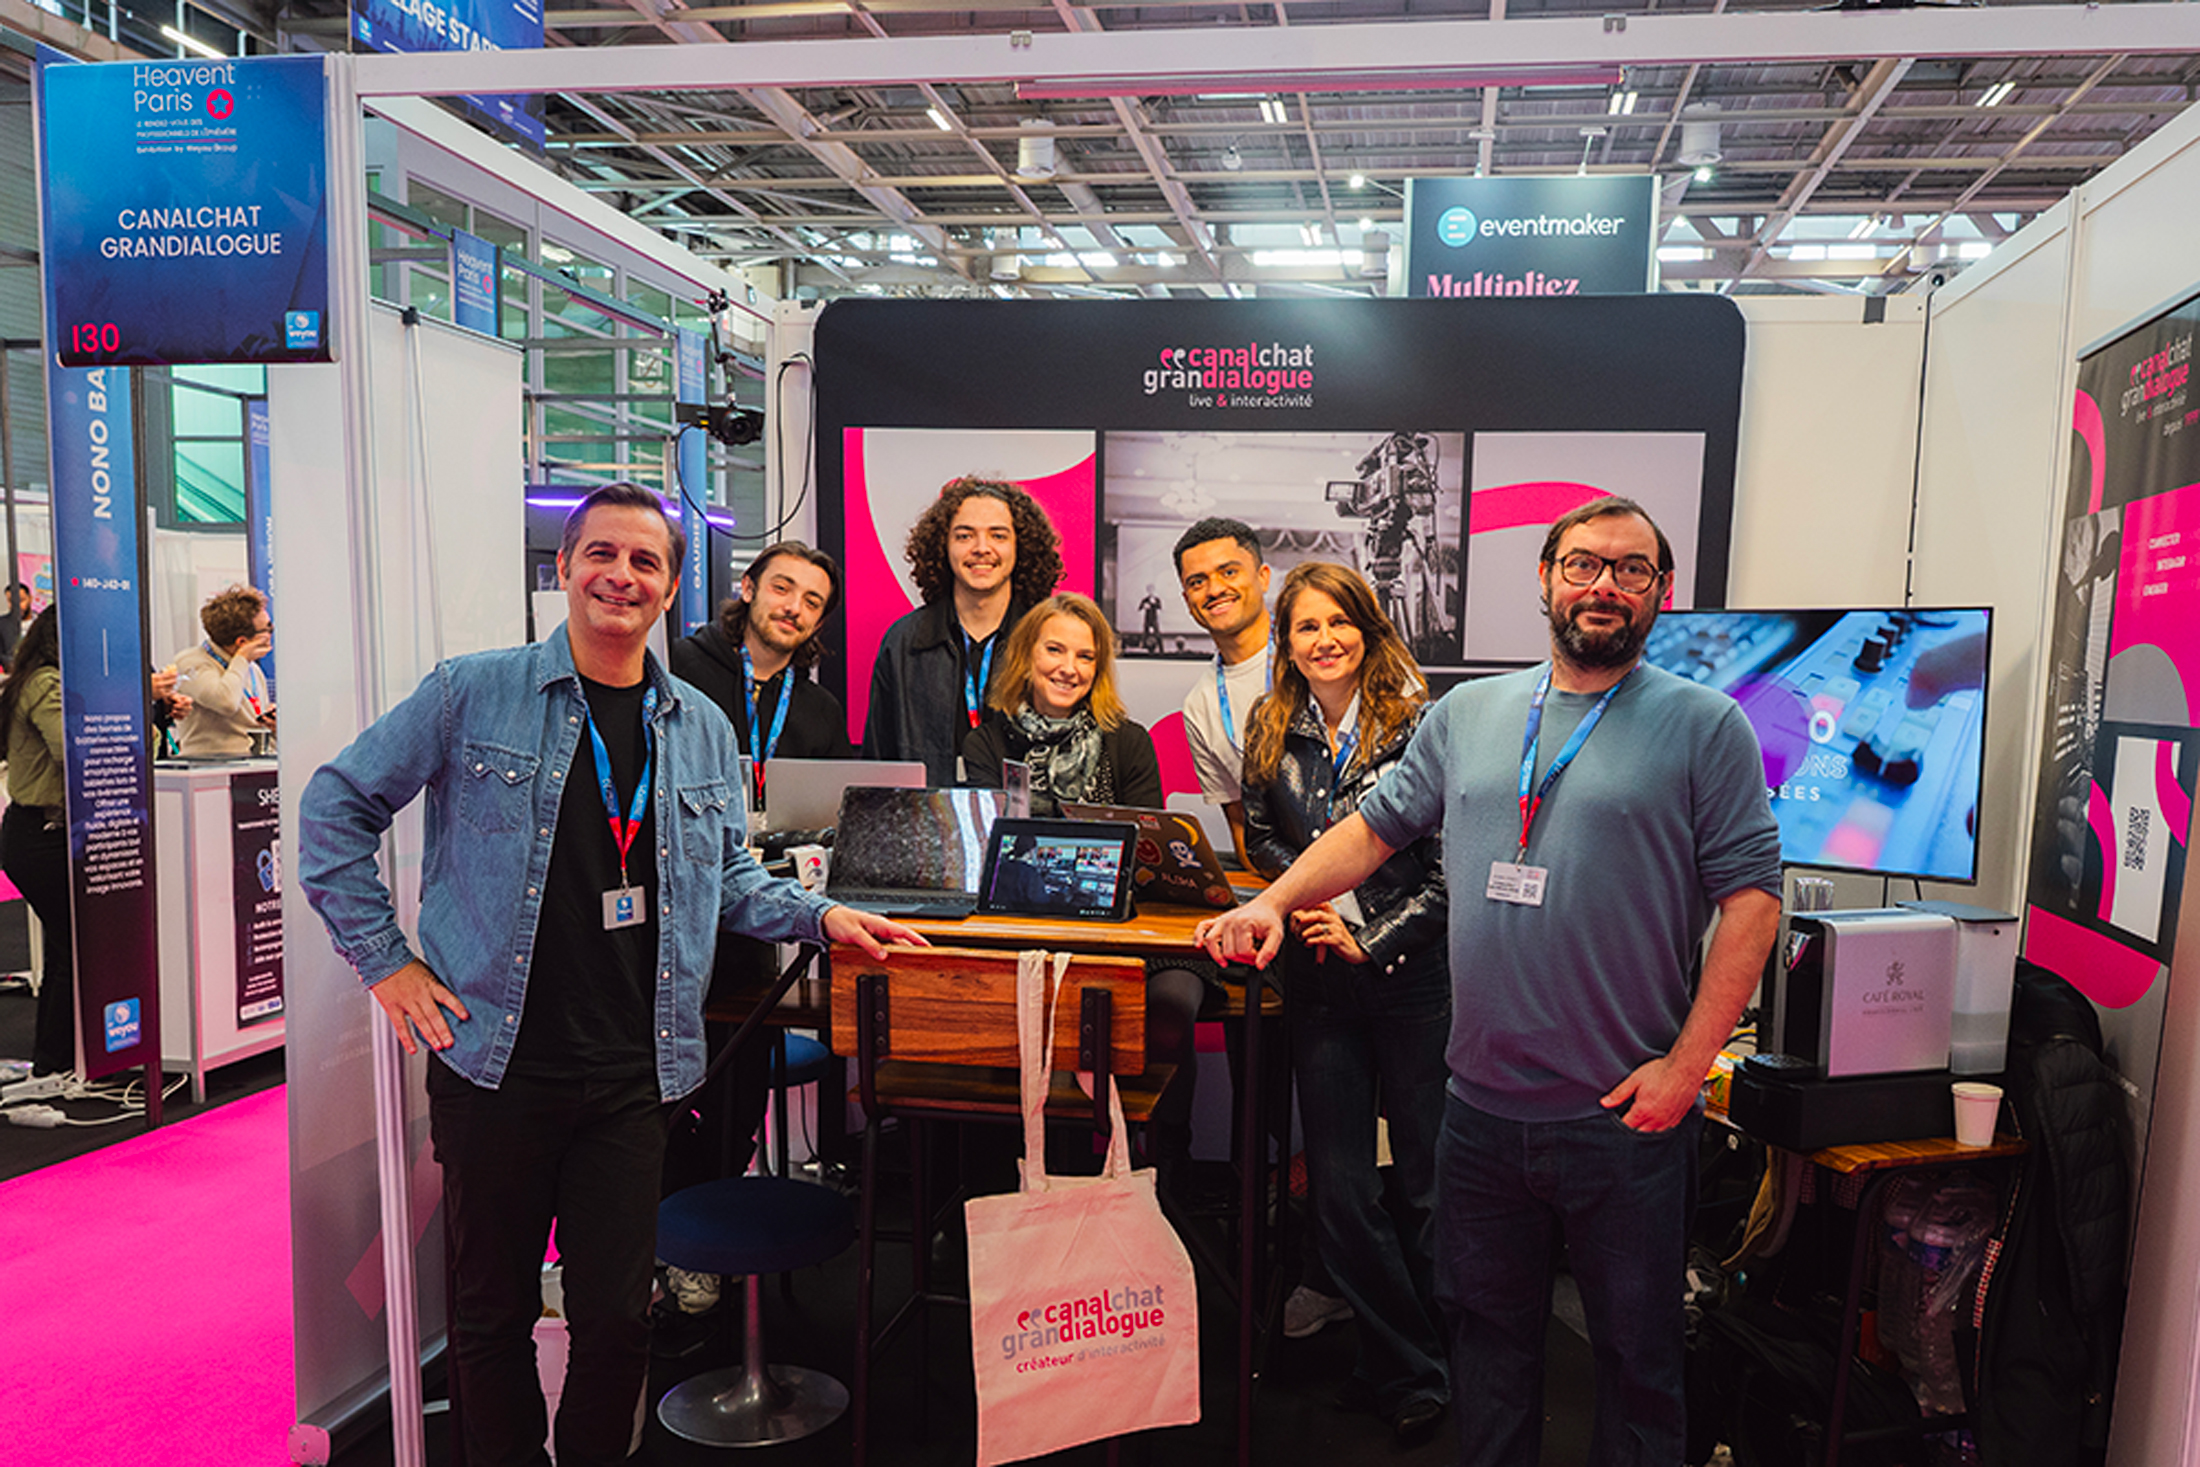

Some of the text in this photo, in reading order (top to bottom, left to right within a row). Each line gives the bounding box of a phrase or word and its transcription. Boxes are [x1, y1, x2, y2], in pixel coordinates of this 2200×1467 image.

[449, 17, 501, 51] STAR
[133, 63, 236, 87] Heavent
[134, 88, 193, 112] Paris
[118, 205, 262, 231] CANALCHAT
[1479, 211, 1625, 238] eventmaker
[100, 233, 282, 259] GRANDIALOGUE
[1427, 270, 1580, 297] Multipliez
[1188, 342, 1313, 367] canalchat
[1143, 364, 1313, 395] grandialogue
[1189, 393, 1313, 407] live & interactivité
[90, 418, 112, 519] NONO
[1044, 1285, 1164, 1323] canalchat
[1002, 1308, 1164, 1360] grandialogue
[1016, 1334, 1166, 1373] créateur d'interactivité
